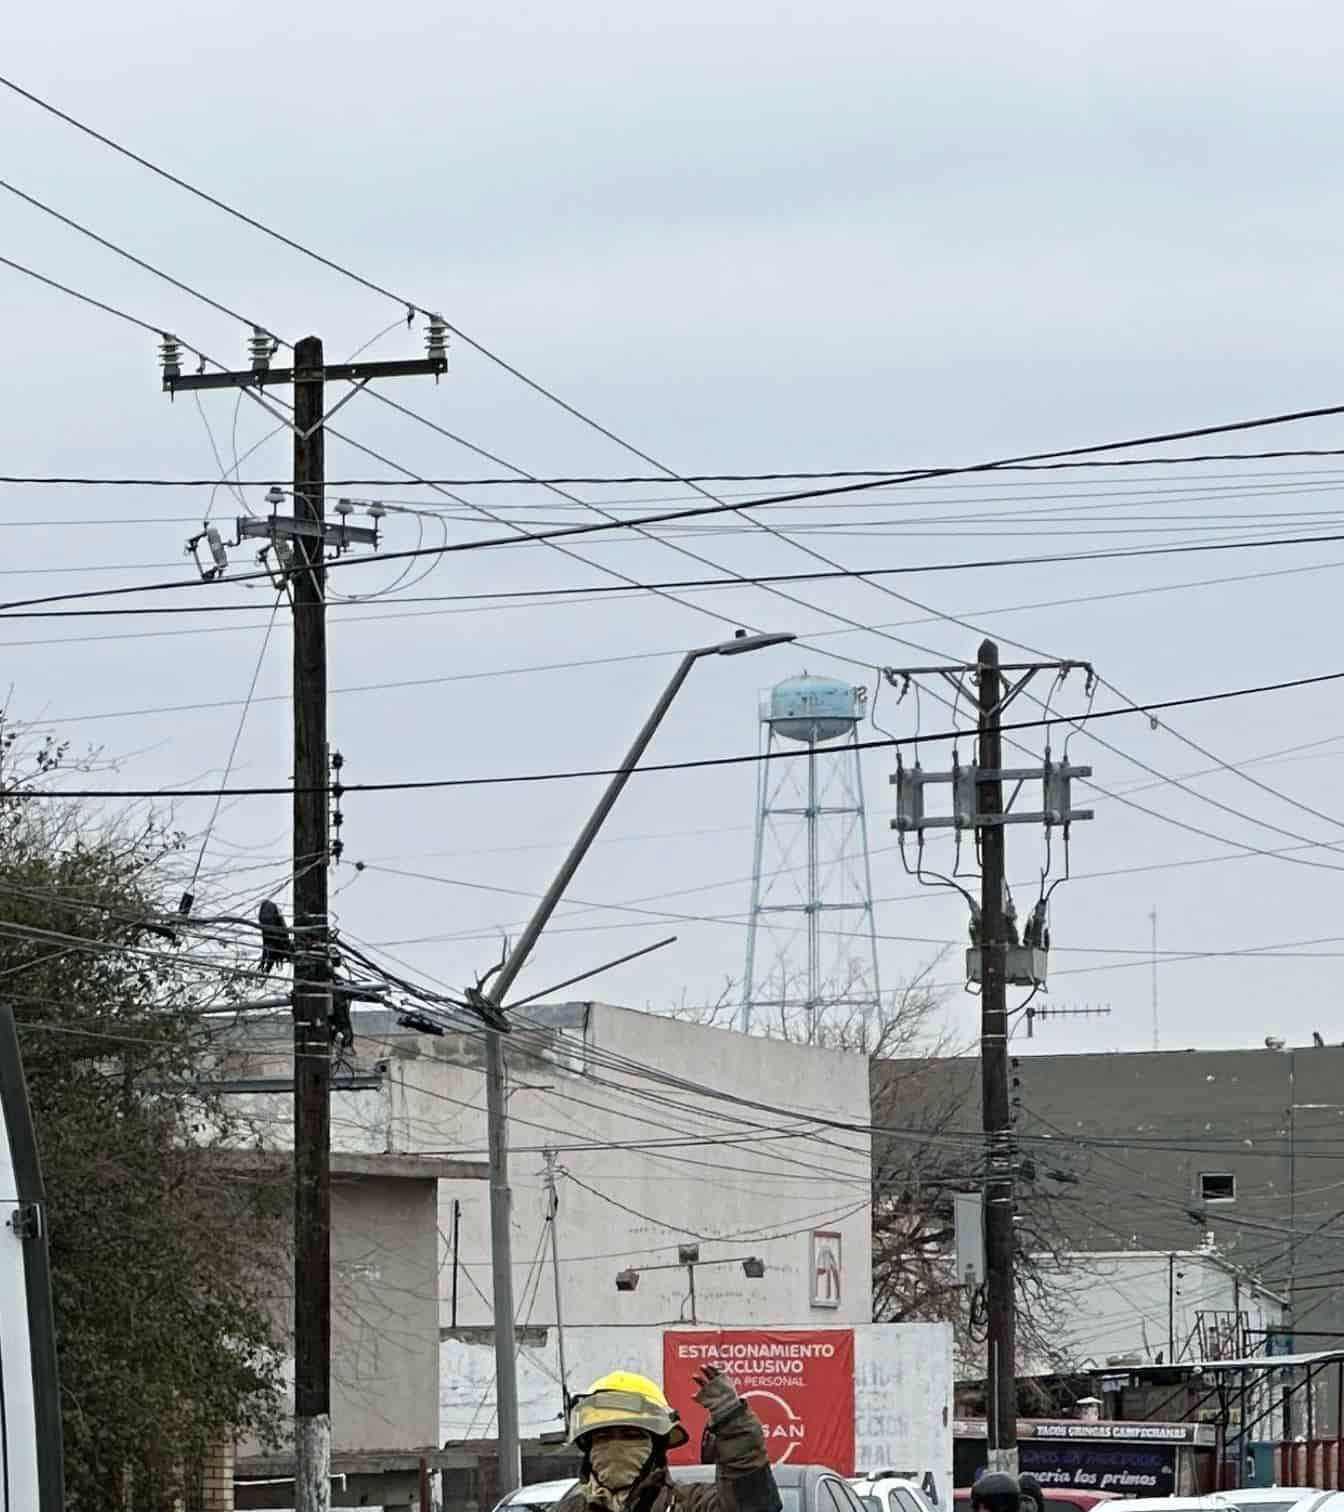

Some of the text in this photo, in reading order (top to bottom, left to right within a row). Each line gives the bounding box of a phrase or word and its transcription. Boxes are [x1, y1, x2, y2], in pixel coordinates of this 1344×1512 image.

[678, 1343, 834, 1359] ESTACIONAMIENTO
[744, 1375, 806, 1386] PERSONAL
[761, 1423, 805, 1438] SAN
[1036, 1425, 1067, 1437] TACOS
[1074, 1468, 1095, 1485] los
[1100, 1468, 1157, 1488] primos
